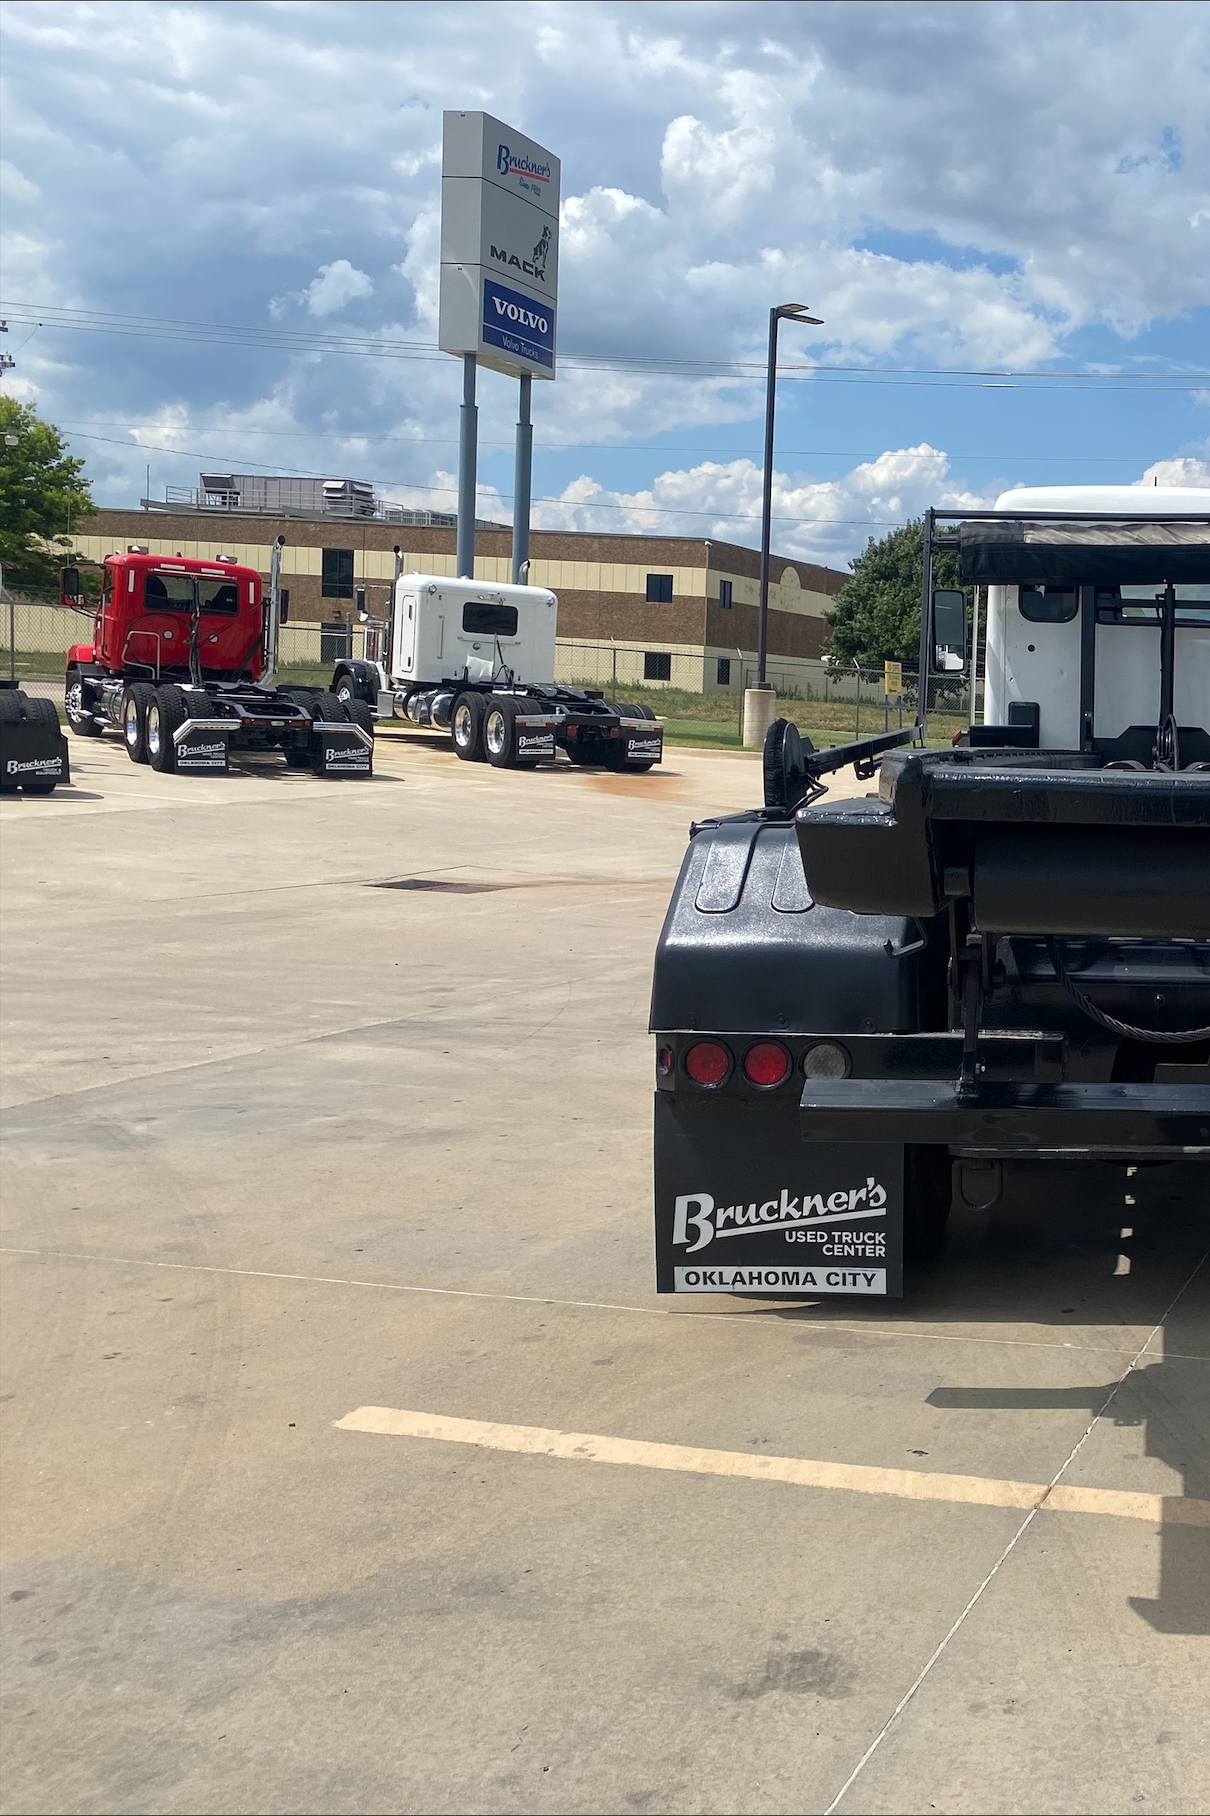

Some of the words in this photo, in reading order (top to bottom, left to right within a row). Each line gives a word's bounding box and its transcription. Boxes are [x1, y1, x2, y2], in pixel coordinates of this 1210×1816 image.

[496, 144, 551, 178] Bruckner's
[490, 245, 546, 283] MACK
[492, 296, 549, 334] VOLVO
[502, 335, 520, 352] Volvo
[520, 342, 539, 360] Trucks
[177, 741, 226, 758] Bruckner's
[325, 746, 370, 761] Bruckner's
[7, 756, 63, 775] Bruckner's
[672, 1176, 888, 1253] Bruckner's
[785, 1230, 828, 1243] USED
[832, 1231, 886, 1244] TRUCK
[822, 1244, 886, 1257] CENTER
[684, 1270, 818, 1286] OKLAHOMA
[825, 1271, 877, 1287] CITY
